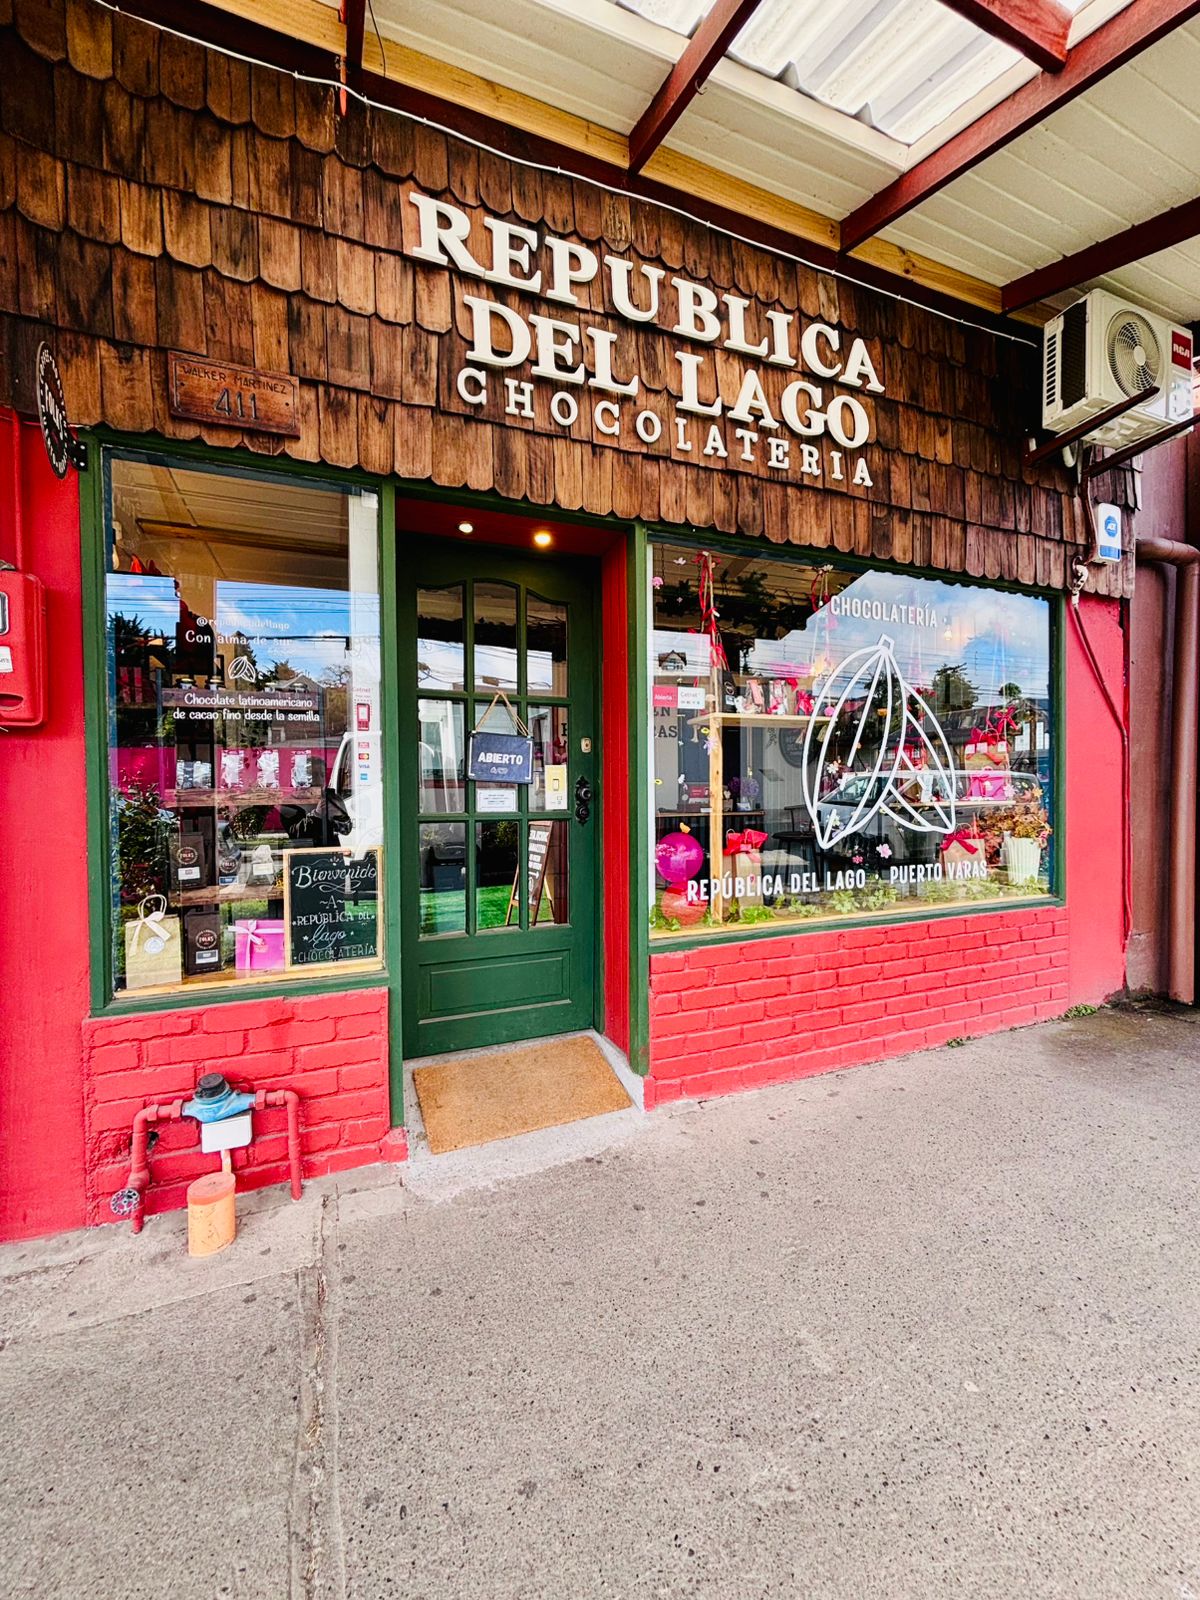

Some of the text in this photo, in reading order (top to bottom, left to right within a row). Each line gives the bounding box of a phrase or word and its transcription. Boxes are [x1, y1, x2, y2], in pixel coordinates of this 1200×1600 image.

[409, 192, 886, 393] REPUBLICA
[1173, 343, 1190, 358] RCA
[182, 364, 288, 395] WALKER MARTINEZ
[463, 294, 870, 449] DEL LAGO
[214, 387, 258, 420] 411
[456, 367, 874, 487] CHOCOLATERIA
[830, 595, 938, 628] CHOCOLATERÍA
[185, 629, 212, 644] Con
[217, 633, 247, 645] alma
[253, 632, 268, 646] de
[184, 692, 313, 708] Chocolate latinoamericano
[172, 707, 320, 721] de cacao fino desde la semilla
[477, 751, 523, 765] ABIERTO
[291, 863, 377, 889] Bienvenido
[889, 859, 988, 884] PUERTO VARAS
[687, 868, 866, 902] REPÚBLICA DEL LAGO
[358, 911, 370, 920] DEL
